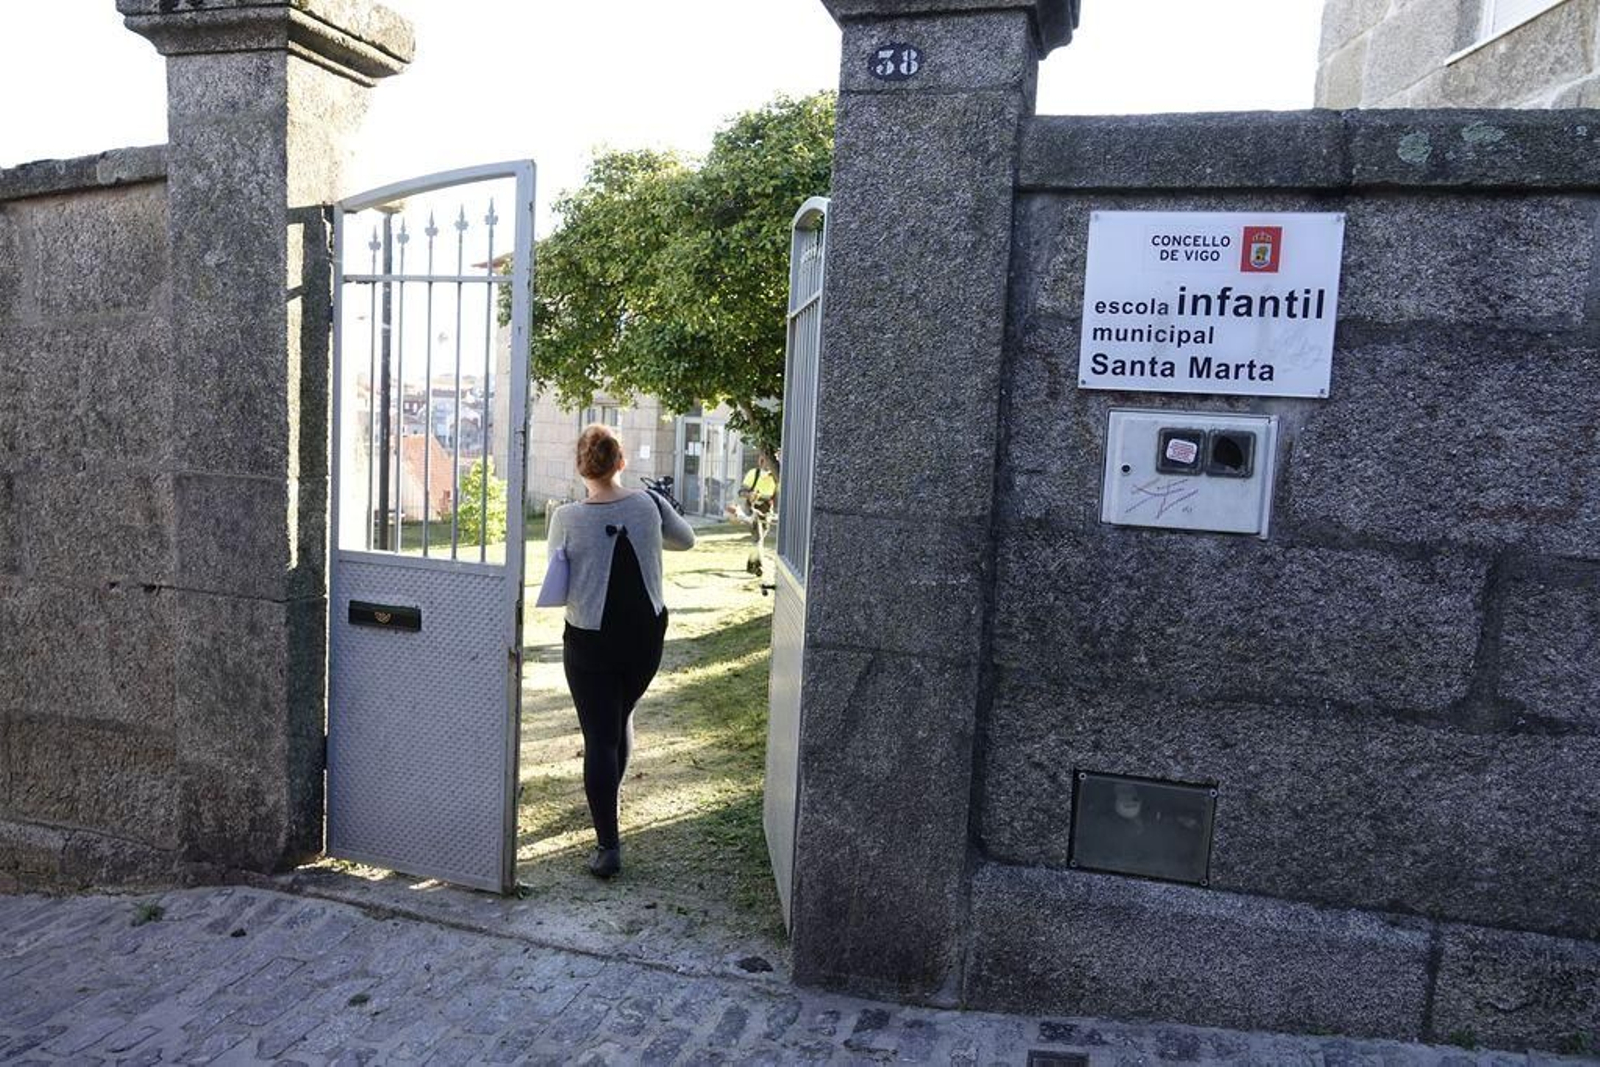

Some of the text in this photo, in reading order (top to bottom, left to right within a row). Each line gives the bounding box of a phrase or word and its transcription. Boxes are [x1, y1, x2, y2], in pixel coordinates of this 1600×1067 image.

[876, 50, 919, 75] 38
[1152, 235, 1230, 247] CONCELLO
[1160, 250, 1220, 261] DE VIGO
[1095, 286, 1325, 319] escola infantil
[1093, 325, 1214, 348] municipal
[1091, 353, 1274, 381] Santa Marta
